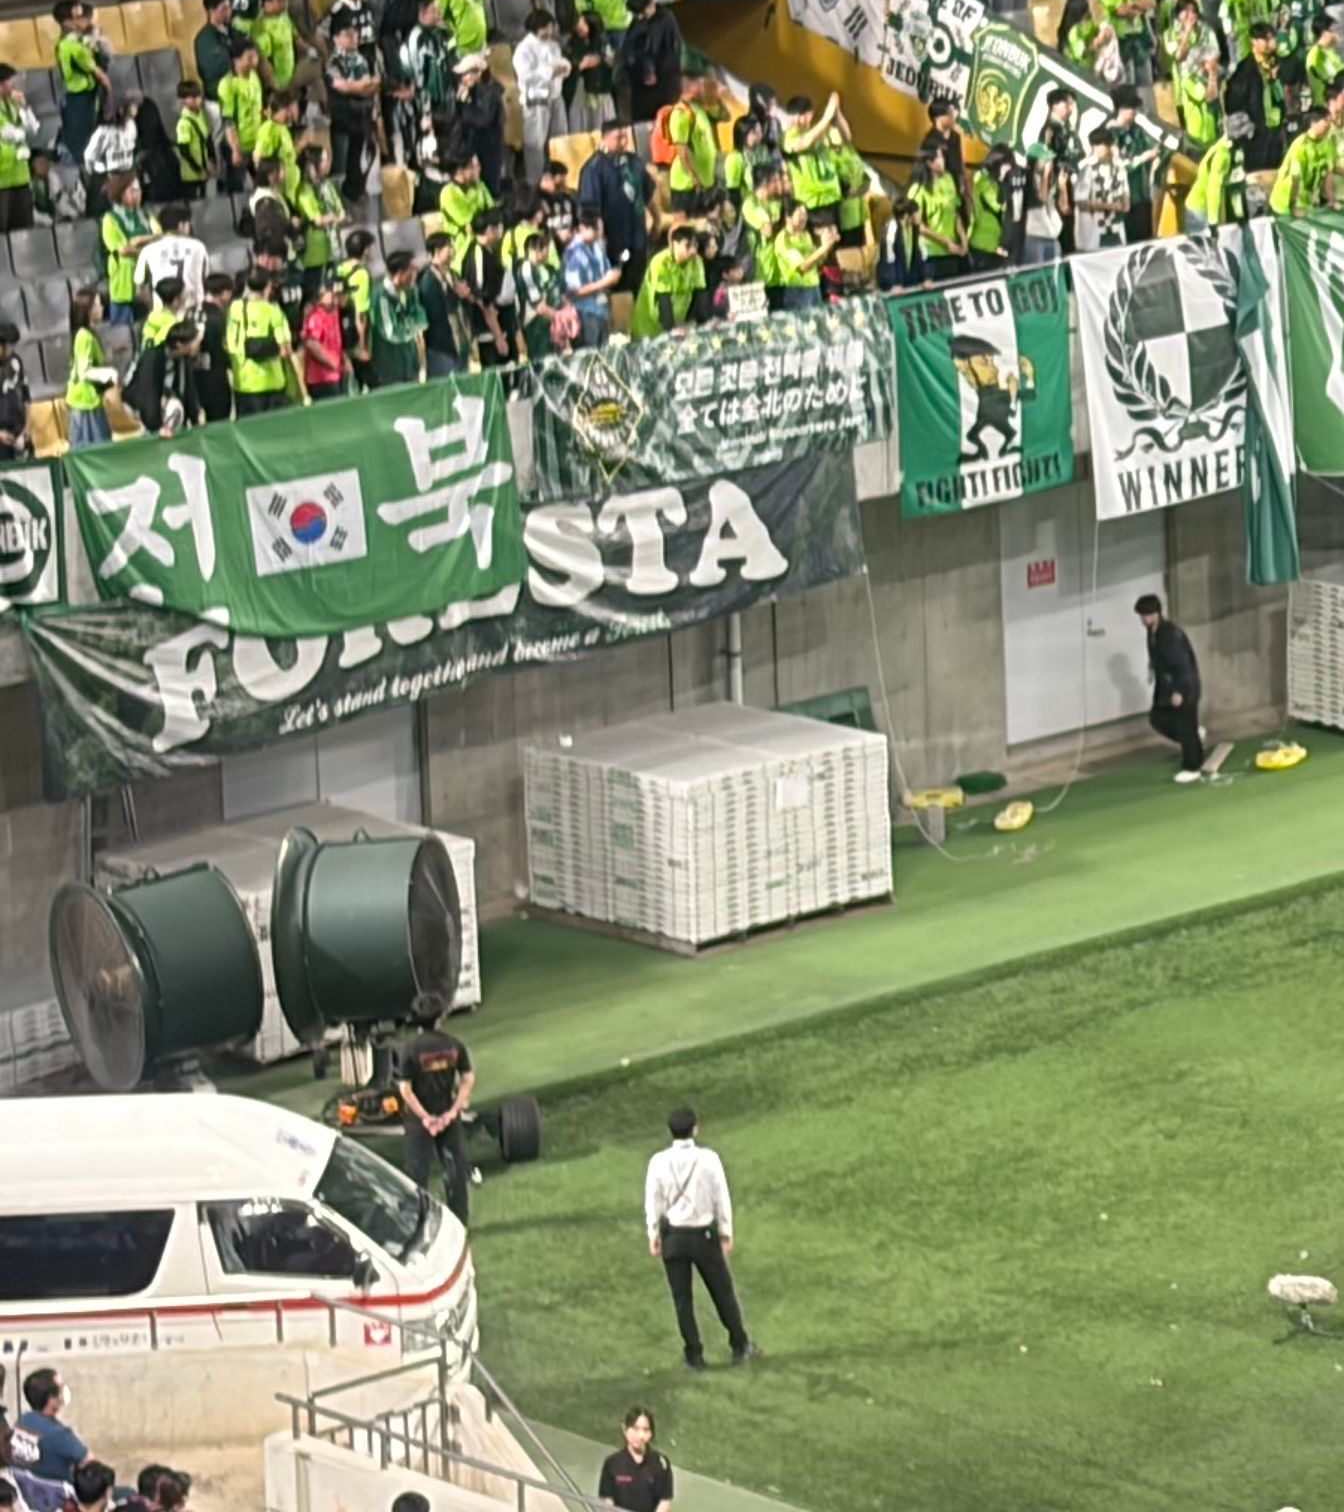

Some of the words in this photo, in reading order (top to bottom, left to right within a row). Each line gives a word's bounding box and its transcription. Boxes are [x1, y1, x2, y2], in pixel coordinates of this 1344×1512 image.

[900, 294, 967, 339] TIME
[968, 287, 1005, 318] TO
[333, 675, 388, 719] stand
